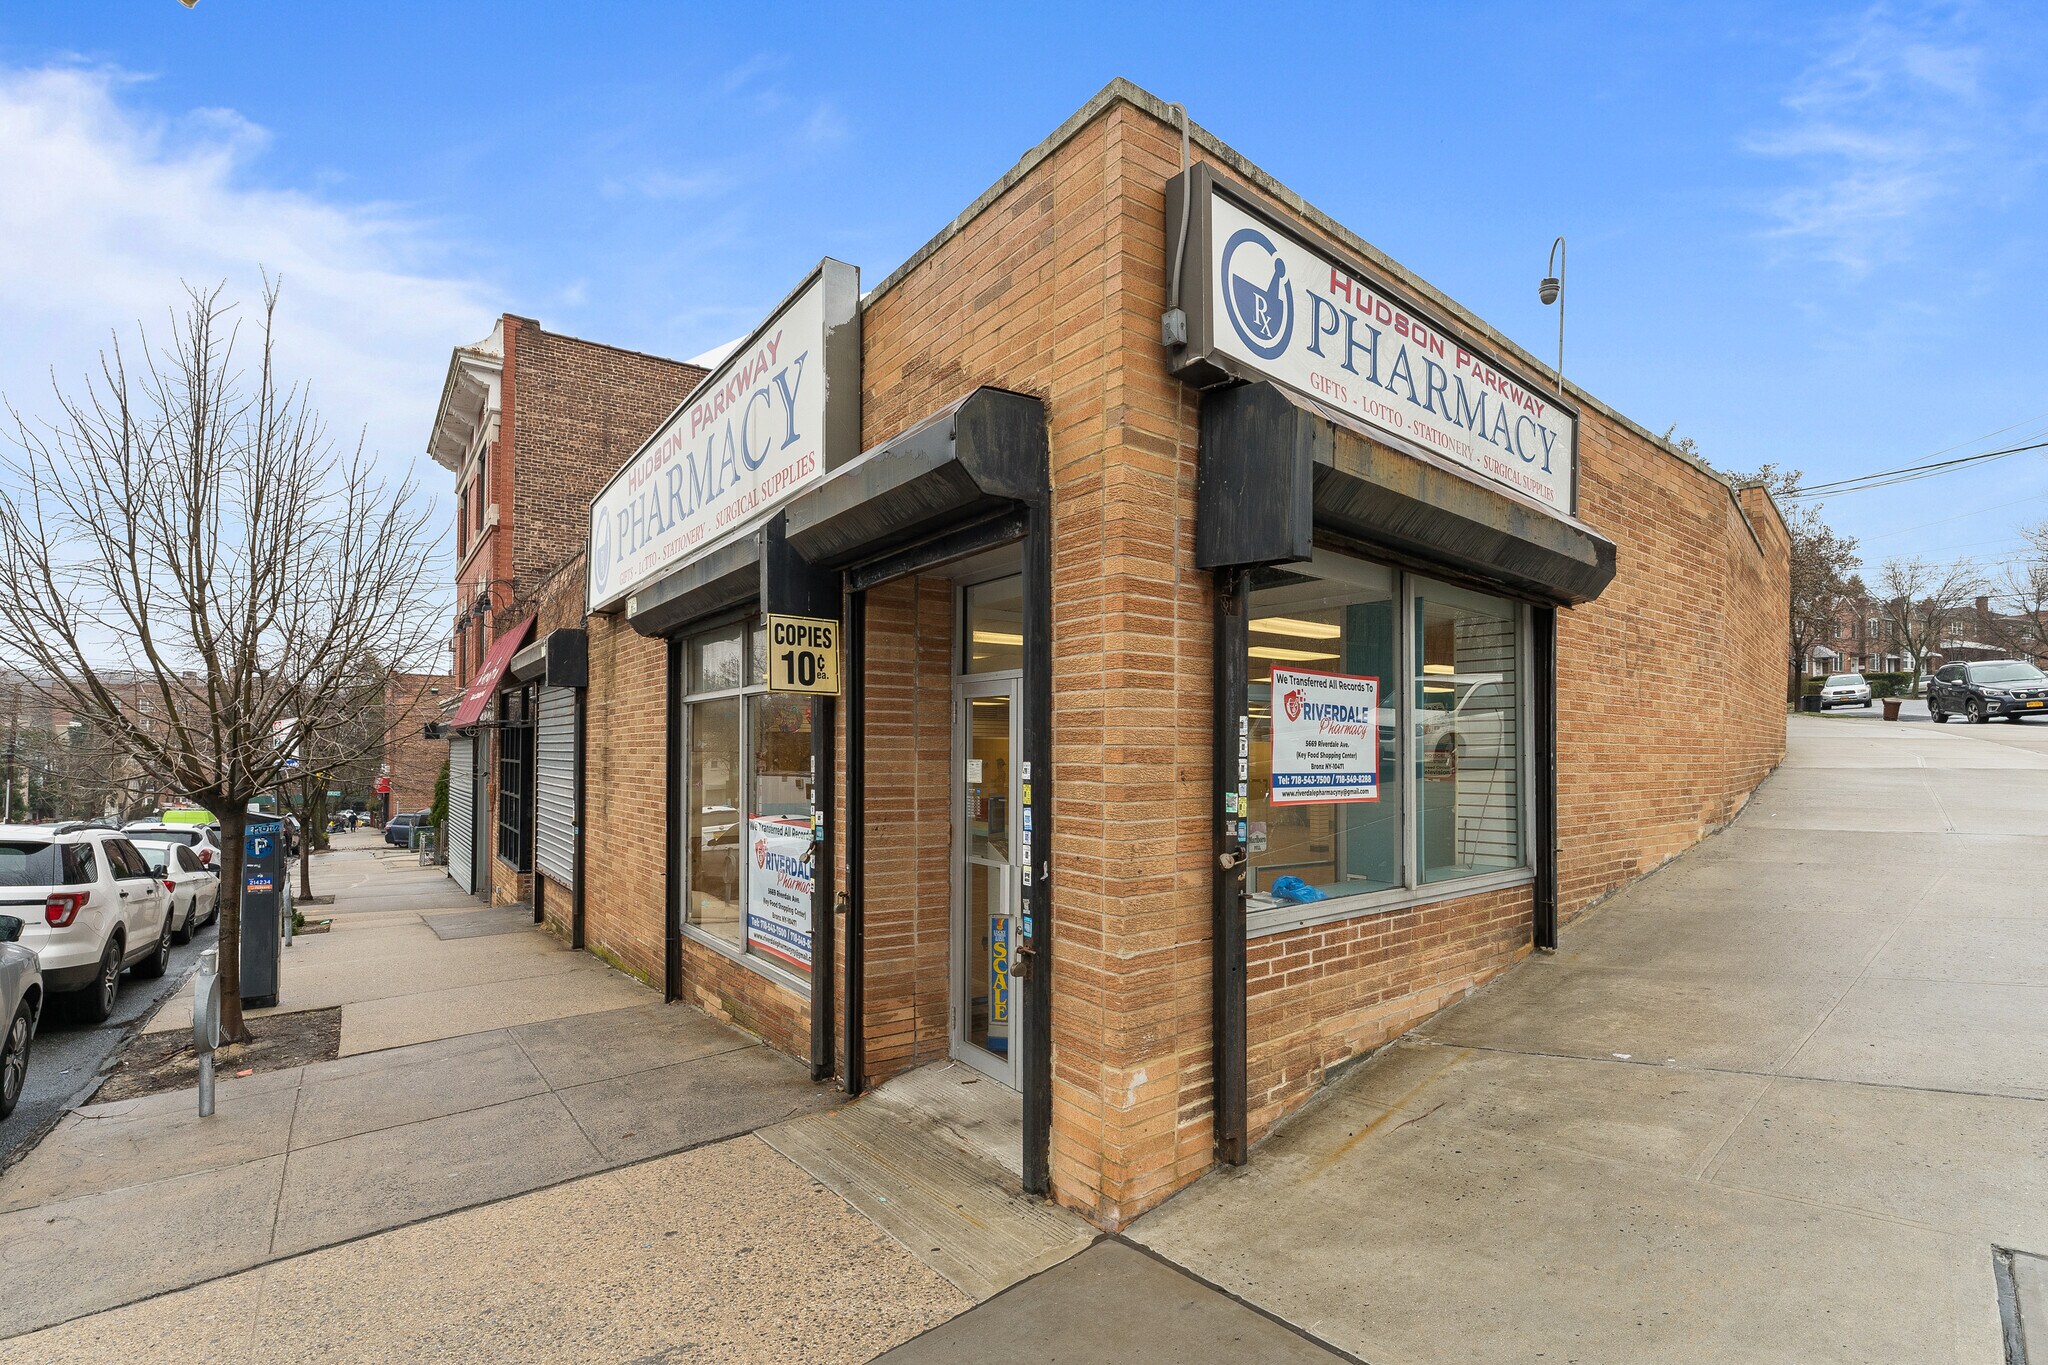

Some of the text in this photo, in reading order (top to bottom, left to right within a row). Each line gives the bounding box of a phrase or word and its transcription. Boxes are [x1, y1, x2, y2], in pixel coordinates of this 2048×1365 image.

[1330, 267, 1546, 419] HUDSON PARKWAY
[1305, 288, 1557, 475] PHARMACY
[627, 329, 783, 497] HUDSON PARKWAY
[1310, 371, 1555, 503] GIFTS LOTTO STATIONERY SURGICAL SUPPLIES
[616, 350, 809, 563] PHARMACY
[662, 521, 706, 561] STATIONERY
[715, 490, 759, 529] SURGICAL
[761, 450, 816, 503] SUPPLIES
[774, 622, 832, 649] COPIES
[816, 671, 829, 680] ea.
[1276, 673, 1374, 693] We Transferred All Records To
[1303, 702, 1369, 724] RIVERDALE
[1319, 716, 1368, 740] Pharmacy
[1295, 751, 1358, 761] (Key Food Shopping Center)
[1317, 739, 1339, 749] Riverdale
[1339, 740, 1350, 749] Ave.
[1310, 762, 1324, 771] Bronx
[1278, 775, 1290, 785] Tel:
[993, 942, 1008, 1020] SCALE
